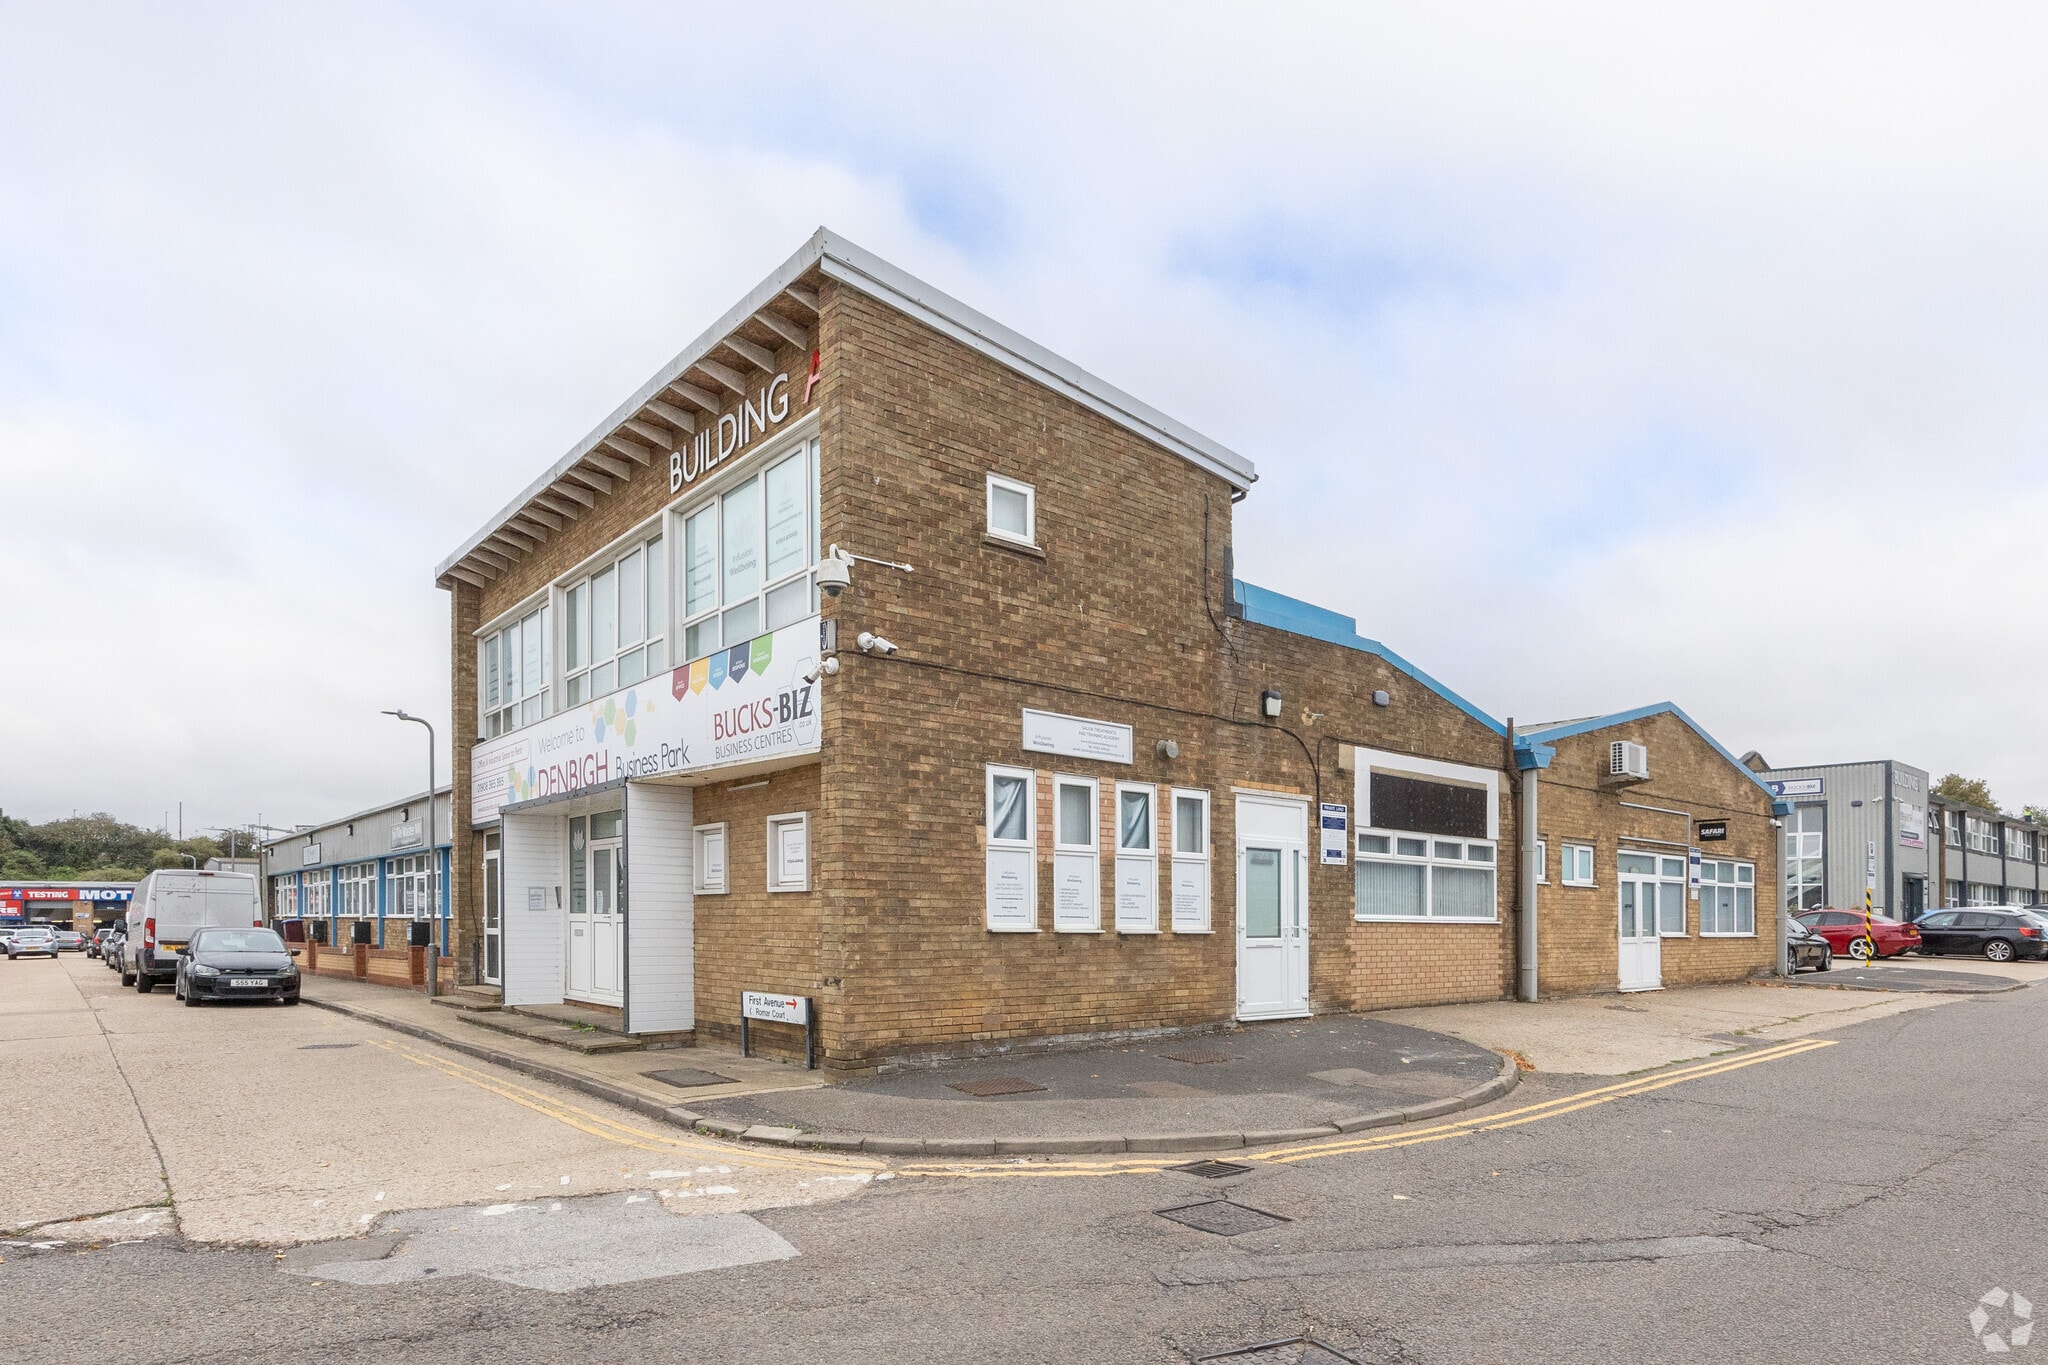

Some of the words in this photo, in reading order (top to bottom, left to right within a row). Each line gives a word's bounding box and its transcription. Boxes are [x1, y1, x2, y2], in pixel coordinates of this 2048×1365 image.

[669, 373, 789, 495] BUILDING
[803, 348, 821, 404] A
[729, 559, 757, 577] Wellbeing
[714, 685, 813, 741] BUCKS-BIZ
[538, 732, 574, 754] Welcome
[576, 725, 585, 742] to
[715, 738, 753, 760] BUSINESS
[754, 728, 793, 750] CENTRES
[1032, 740, 1055, 749] Wellbeing
[538, 749, 608, 798] DENBIGH
[615, 751, 658, 779] Business
[661, 737, 691, 770] Park
[1700, 827, 1725, 835] SAFARI
[79, 889, 132, 900] MOT
[748, 995, 762, 1006] First
[763, 997, 785, 1008] Avenue
[771, 1010, 786, 1019] Court
